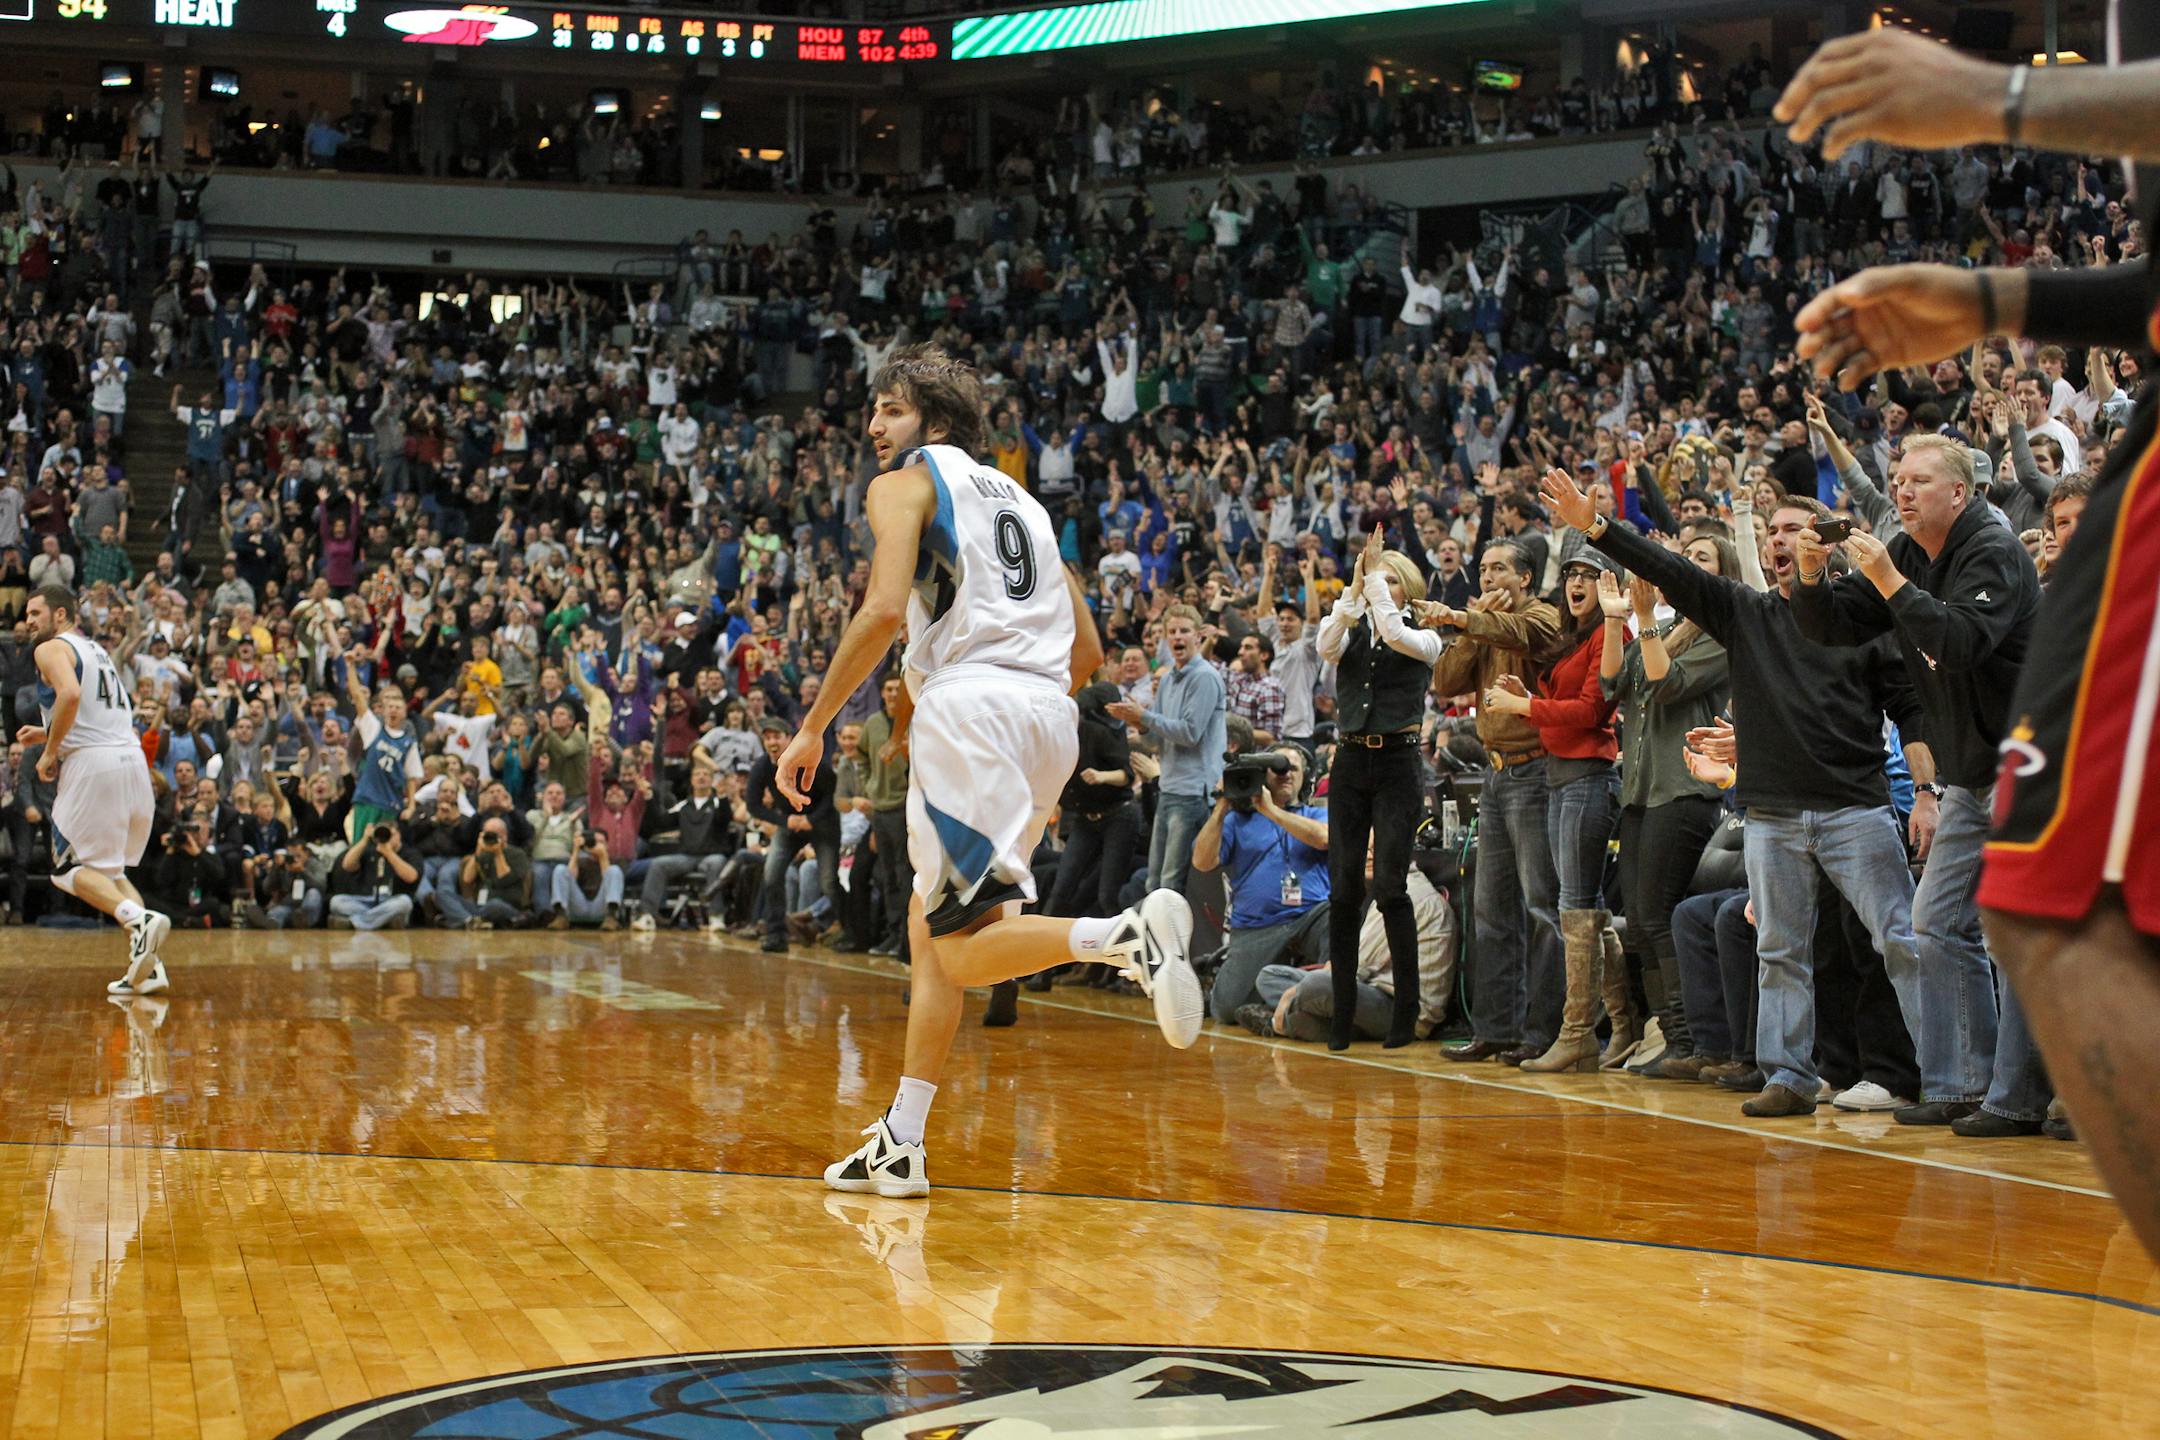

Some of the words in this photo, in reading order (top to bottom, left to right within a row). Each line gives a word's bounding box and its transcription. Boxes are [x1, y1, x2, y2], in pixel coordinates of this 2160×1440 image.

[155, 0, 238, 27] HEAT
[327, 12, 347, 37] 4
[722, 38, 736, 57] 3
[798, 26, 844, 44] HOU
[858, 28, 884, 45] 87
[898, 26, 930, 43] 4th
[798, 44, 846, 60] MEM
[858, 45, 896, 62] 102
[898, 42, 938, 59] 4:39
[994, 509, 1037, 601] 9
[97, 666, 126, 709] 42
